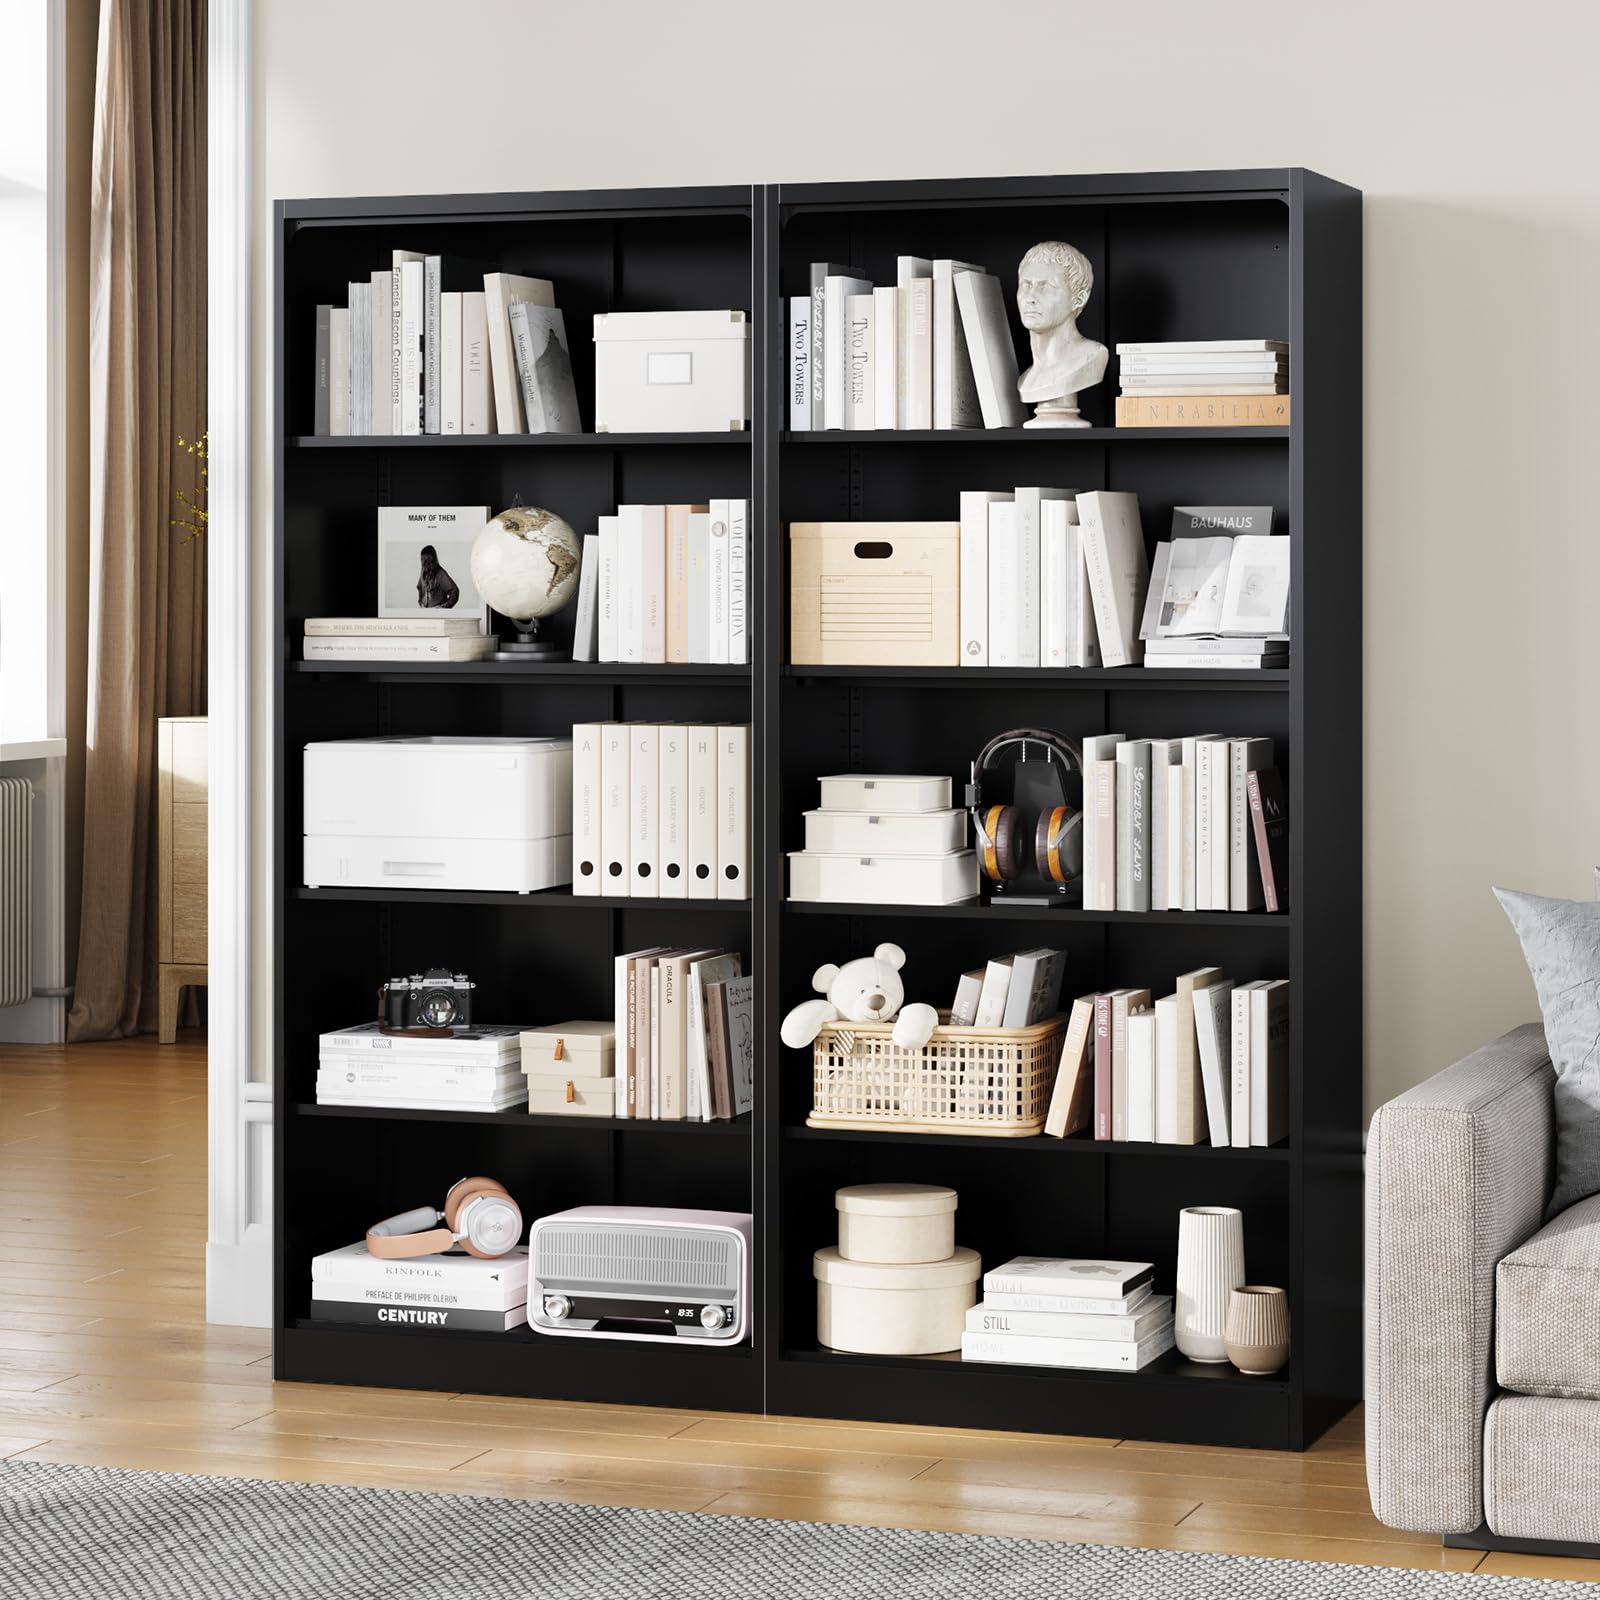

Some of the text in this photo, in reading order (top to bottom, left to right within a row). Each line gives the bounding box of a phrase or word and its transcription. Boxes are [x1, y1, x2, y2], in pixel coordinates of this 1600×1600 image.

[393, 267, 401, 307] Francis
[393, 311, 401, 345] Bacon
[517, 333, 530, 374] Wuthering
[1190, 516, 1254, 528] BAUHAUS
[582, 740, 591, 752] A
[611, 740, 619, 752] P
[640, 741, 648, 753] C
[668, 741, 677, 753] S
[698, 742, 707, 753] H
[727, 742, 736, 754] E
[640, 784, 648, 841] CONSTRUCTION
[385, 1266, 443, 1278] KINFOLK
[365, 1290, 393, 1300] PREFACE
[394, 1292, 402, 1300] DE
[404, 1292, 432, 1302] PHILIPPE
[377, 1308, 449, 1325] CENTURY
[983, 1315, 1011, 1331] STILL
